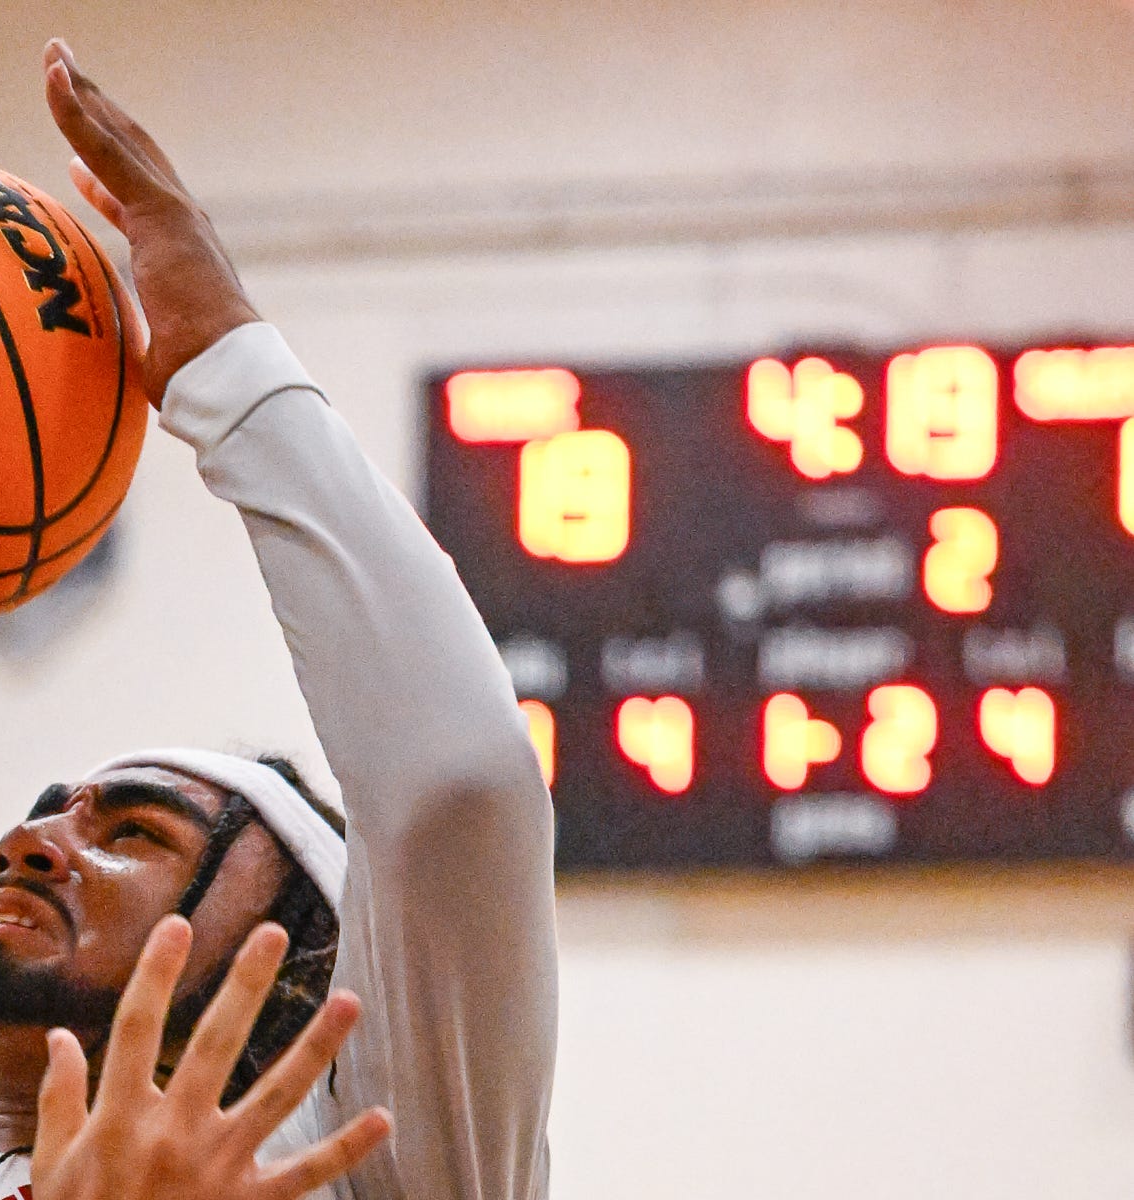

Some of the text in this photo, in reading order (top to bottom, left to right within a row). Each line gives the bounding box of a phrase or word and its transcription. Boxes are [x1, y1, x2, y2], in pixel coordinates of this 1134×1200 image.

[923, 507, 999, 615] 2
[617, 695, 694, 793] 4
[978, 686, 1056, 787] 4
